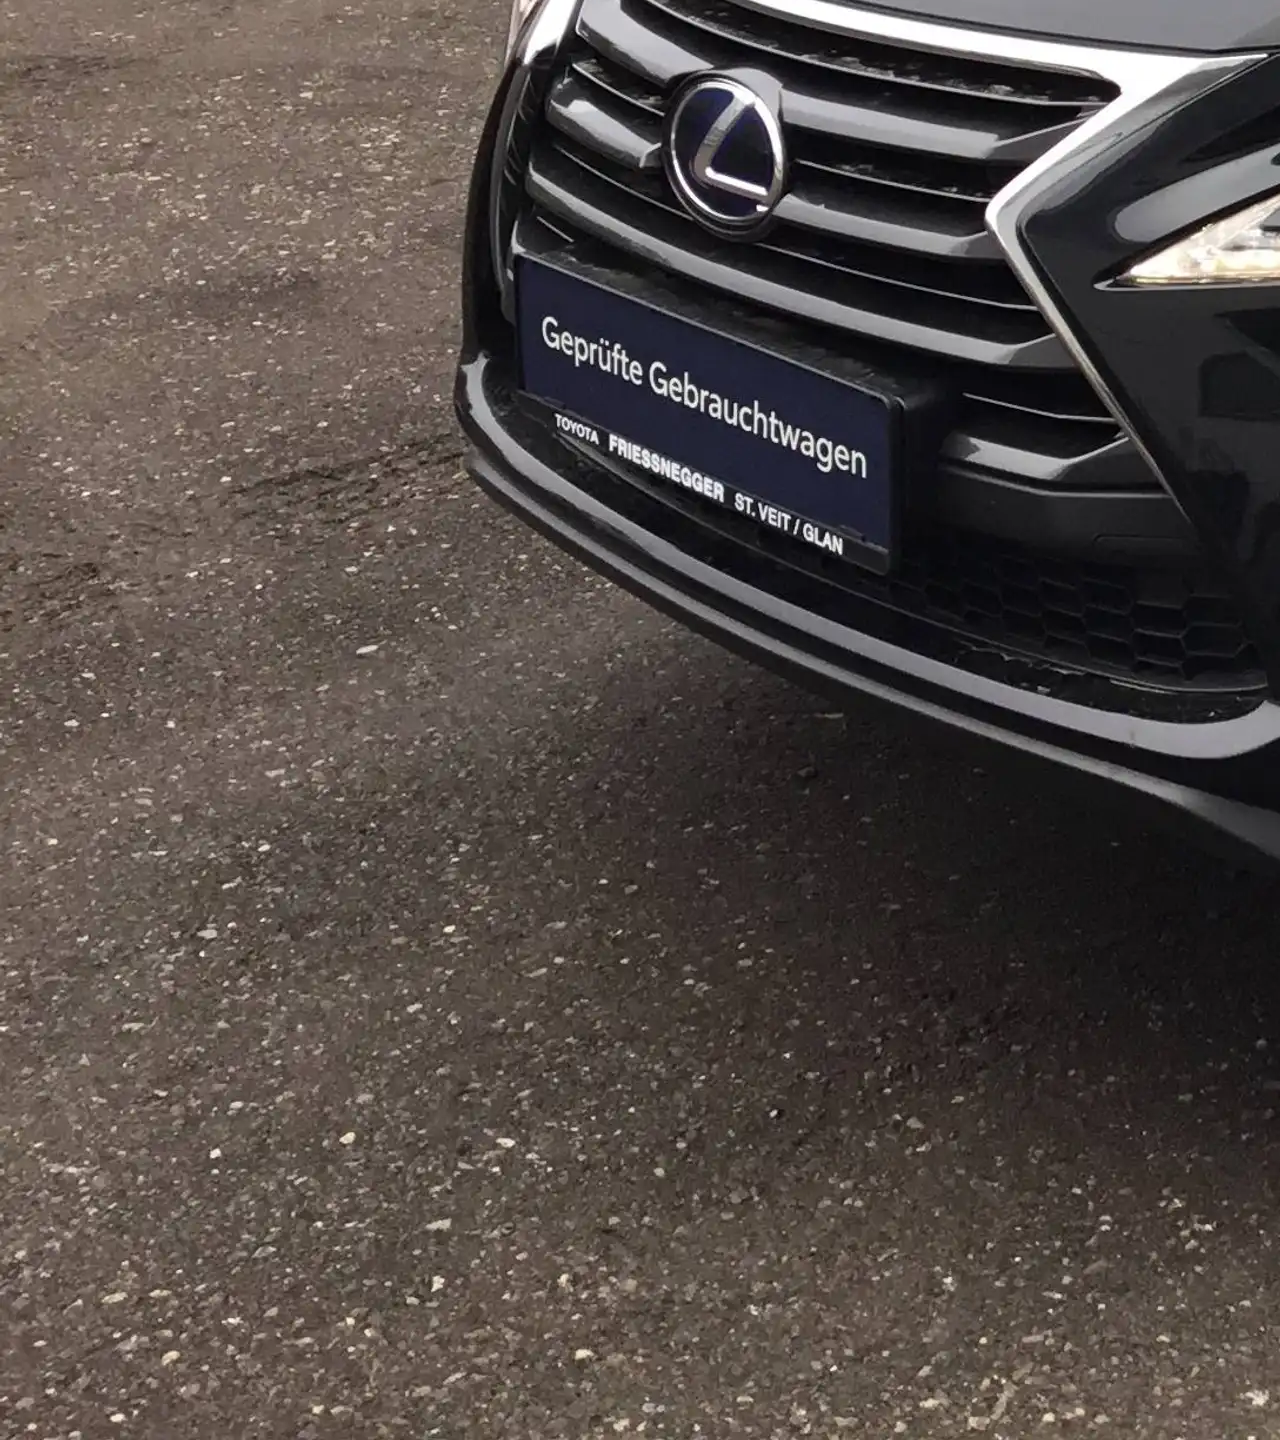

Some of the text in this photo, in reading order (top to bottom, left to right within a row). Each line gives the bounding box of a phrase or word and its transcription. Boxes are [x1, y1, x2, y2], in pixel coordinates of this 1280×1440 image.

[541, 316, 867, 479] Geprüfte Gebrauchtwagen
[554, 412, 845, 556] TOYOTA FRIESSNEGGER ST. VEIT / GLAN
